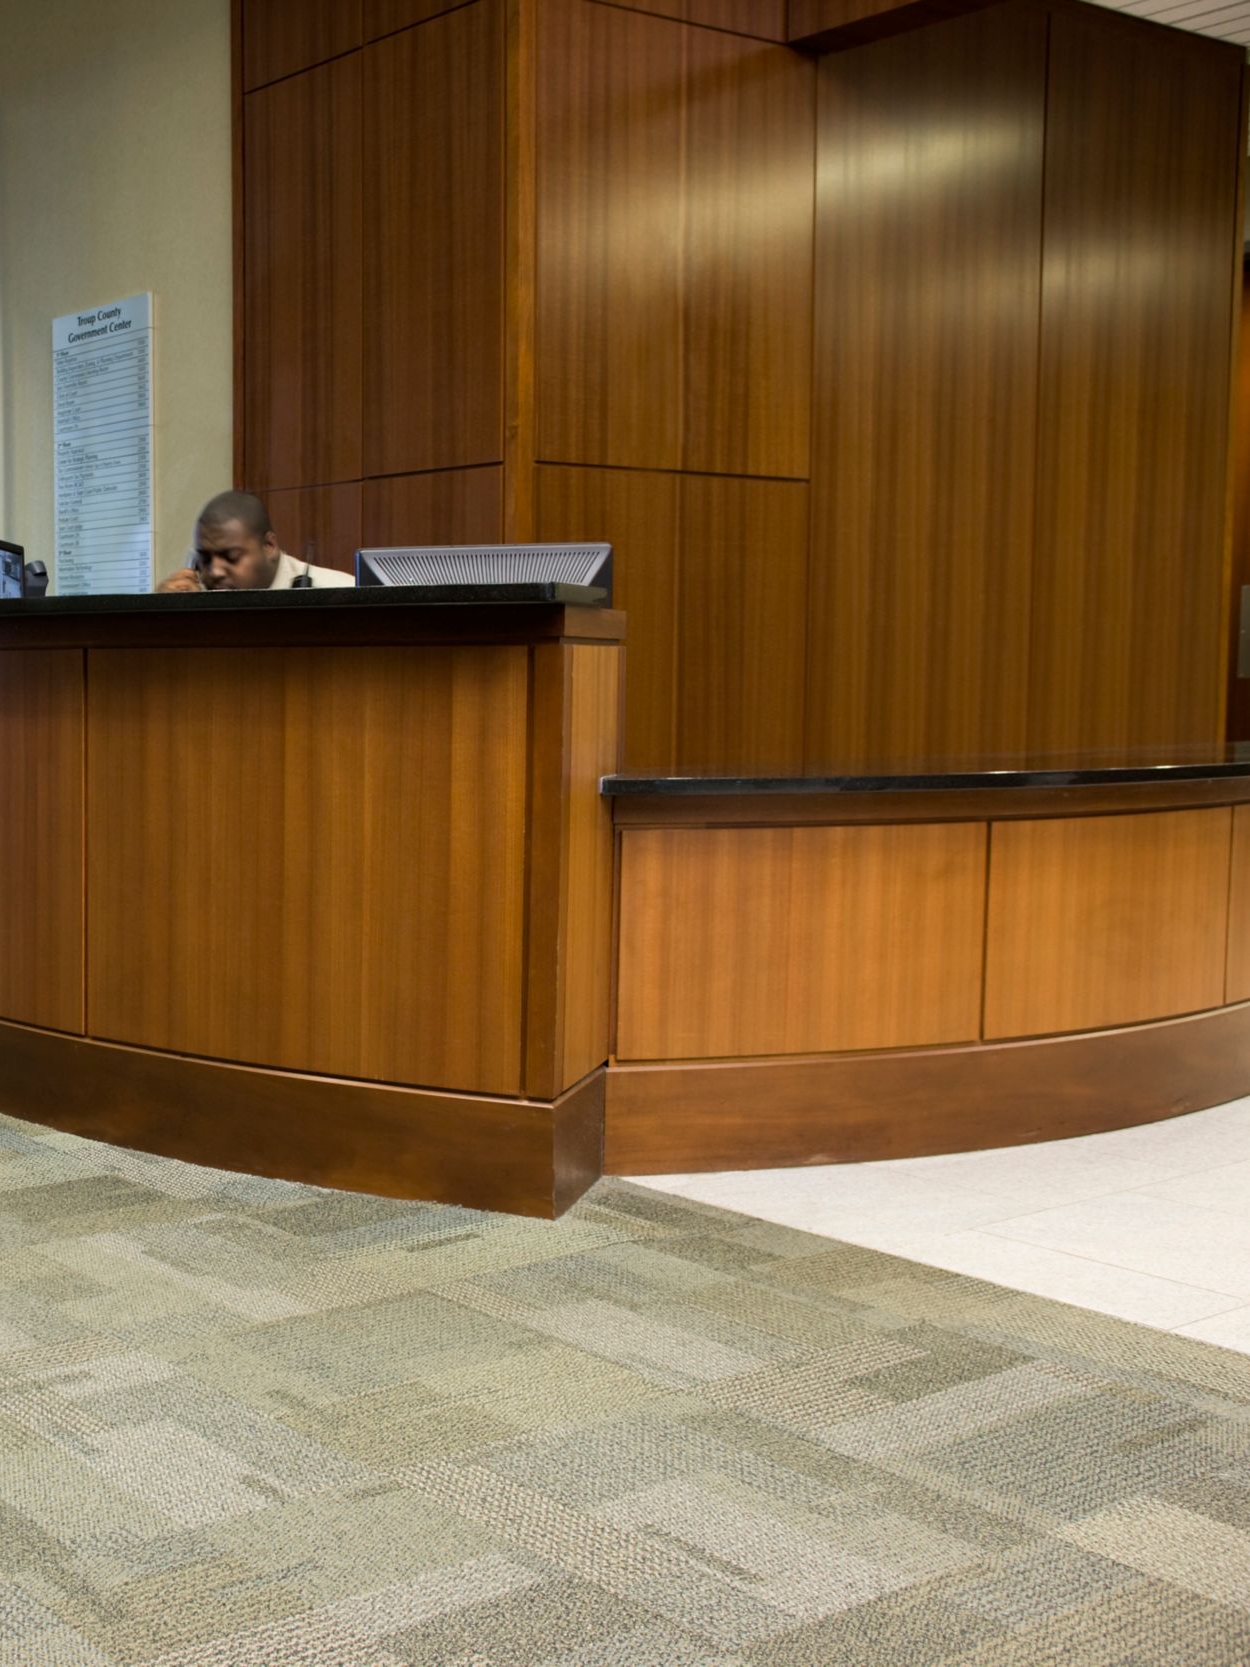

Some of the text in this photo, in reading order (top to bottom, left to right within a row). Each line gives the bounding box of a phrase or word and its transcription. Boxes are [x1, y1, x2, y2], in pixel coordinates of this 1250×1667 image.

[77, 307, 121, 326] Troup County
[68, 320, 132, 343] Government Center
